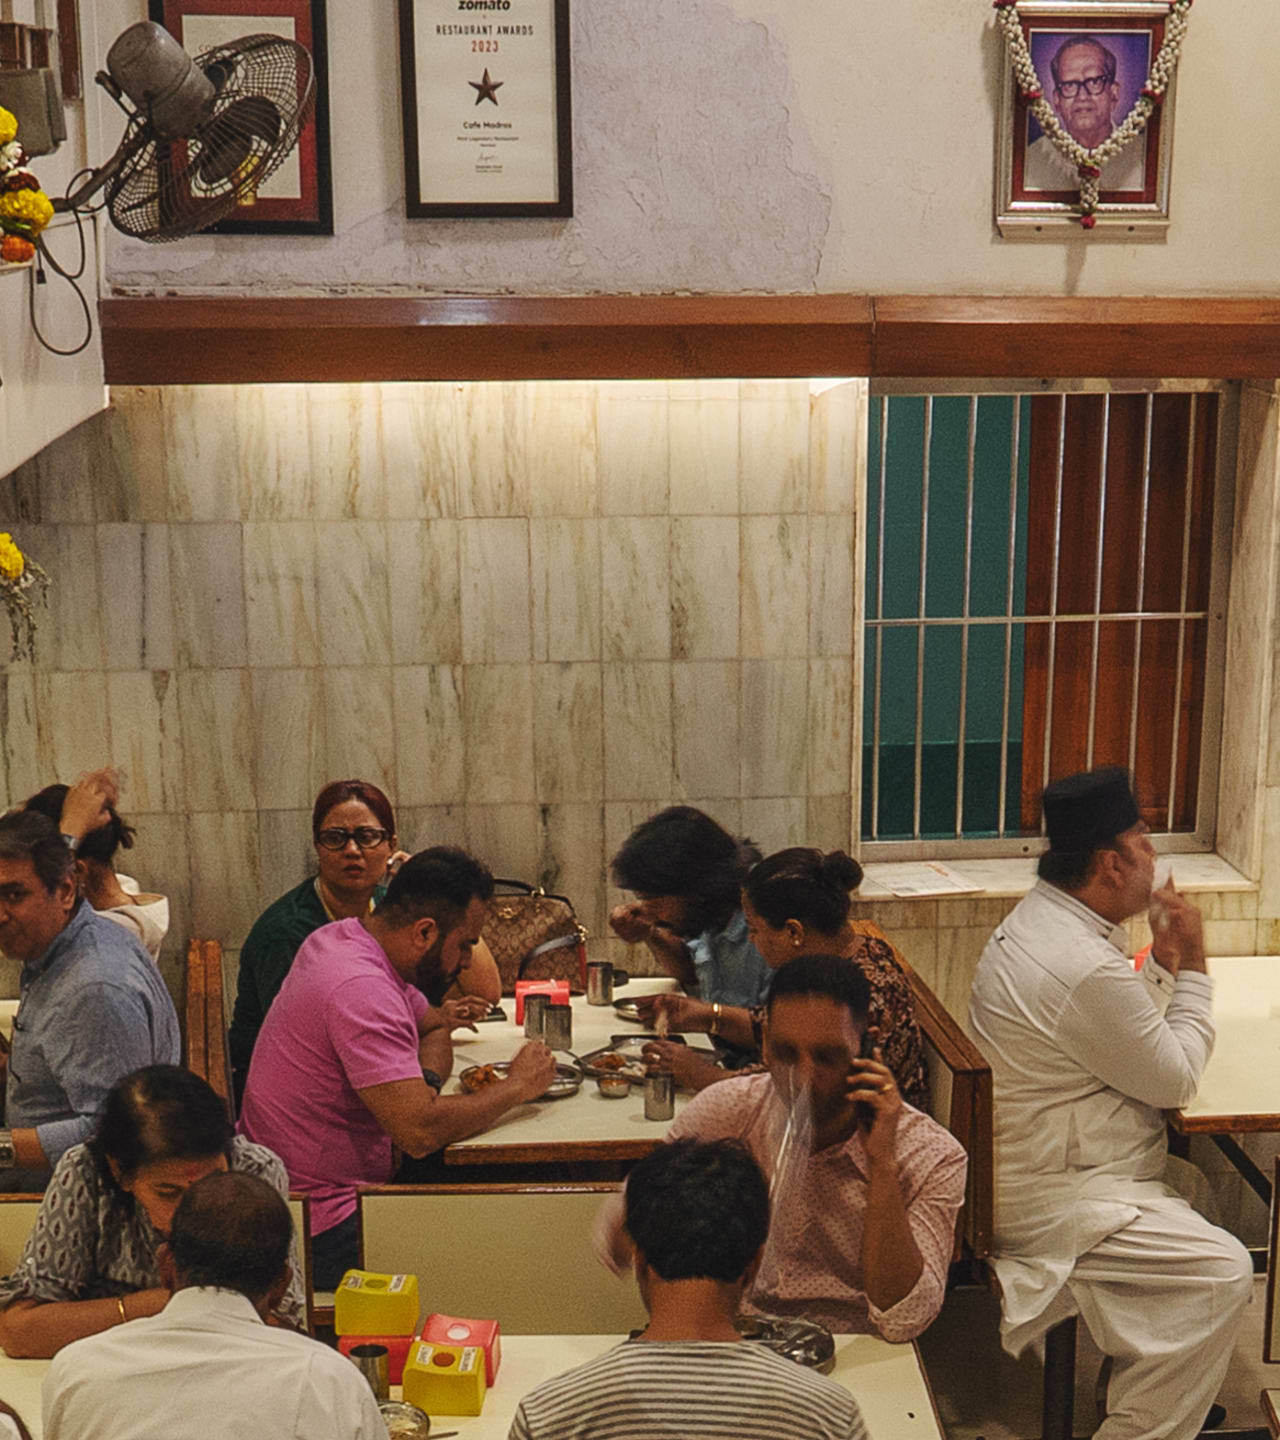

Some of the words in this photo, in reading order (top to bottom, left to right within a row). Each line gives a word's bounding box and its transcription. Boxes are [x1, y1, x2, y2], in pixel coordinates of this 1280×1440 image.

[458, 0, 510, 10] zomato
[436, 25, 493, 36] RESTAURANT
[497, 25, 534, 36] AWARDS
[472, 40, 499, 52] 2023
